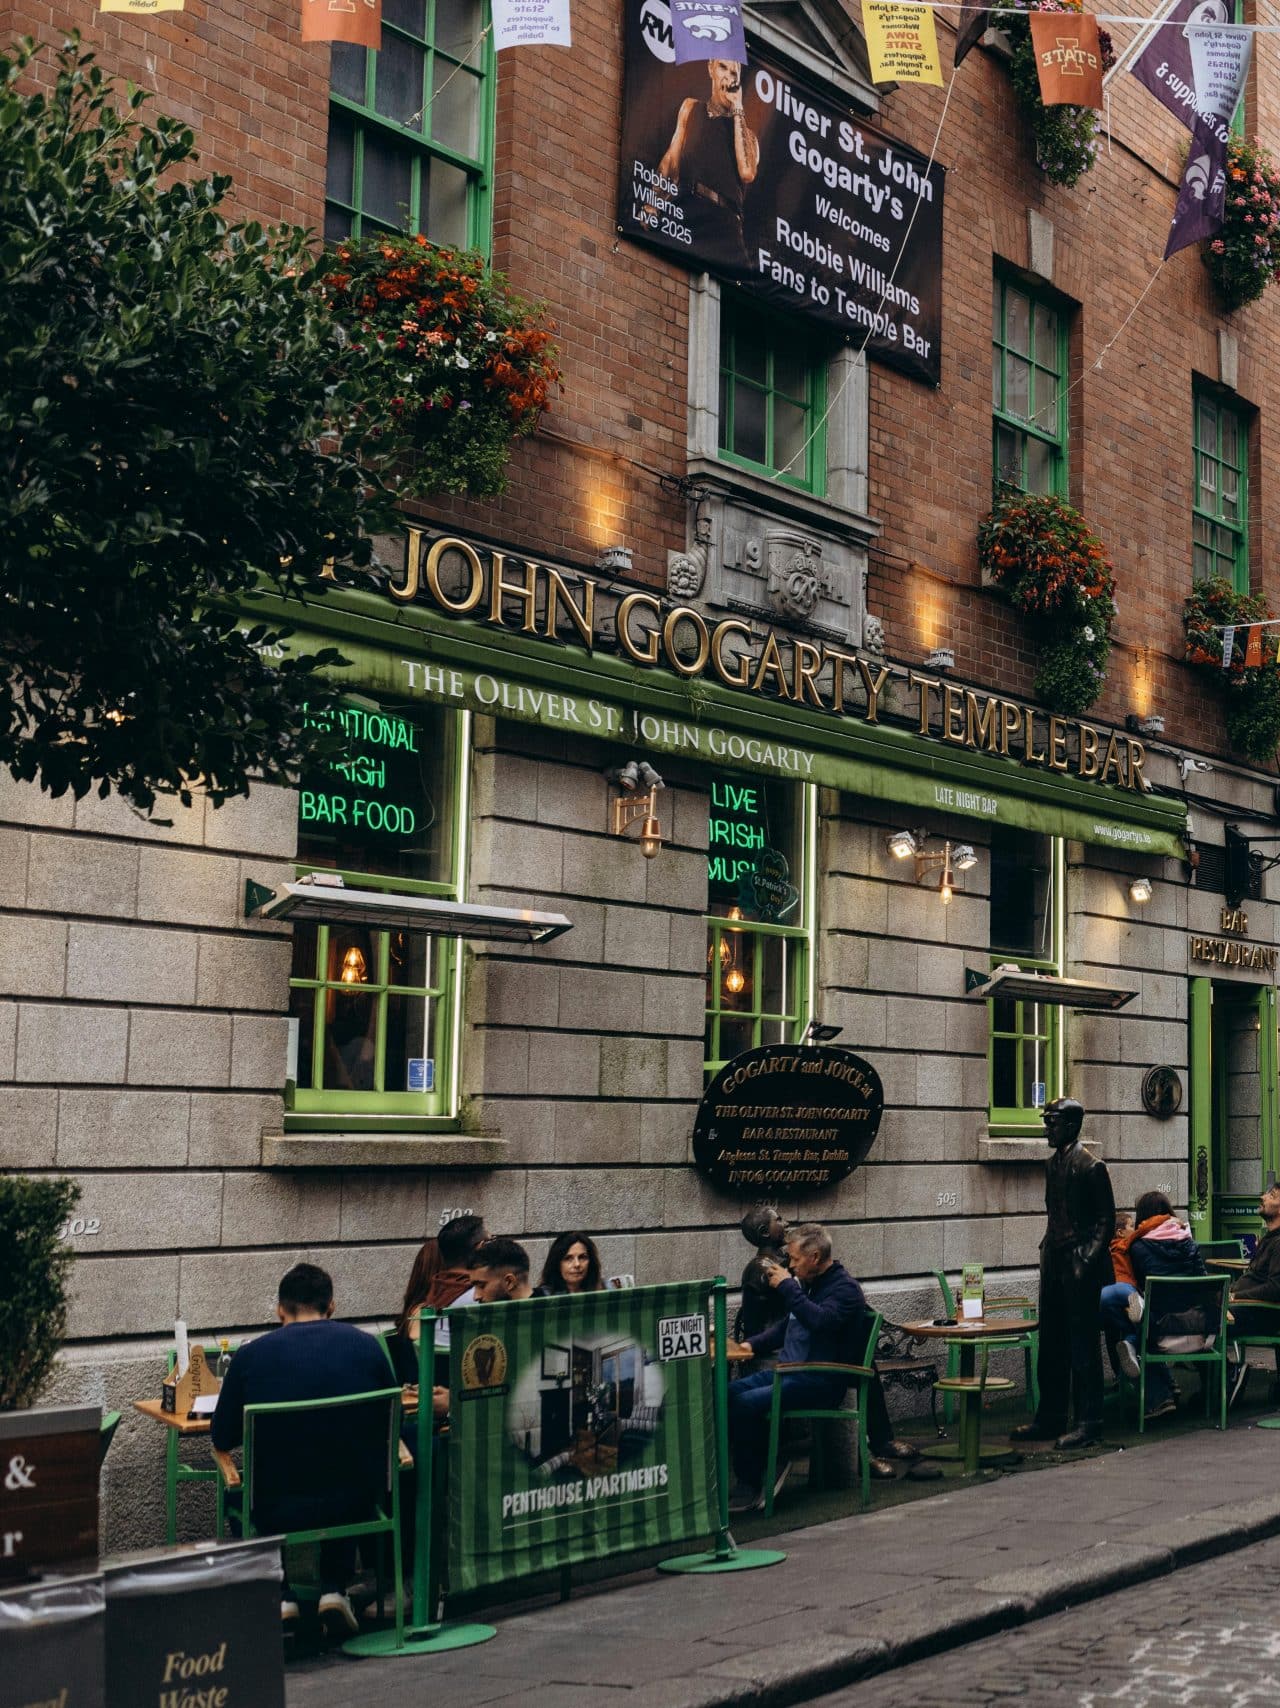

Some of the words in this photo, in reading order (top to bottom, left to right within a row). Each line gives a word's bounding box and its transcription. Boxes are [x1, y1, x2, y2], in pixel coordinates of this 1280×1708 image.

[1155, 62, 1169, 78] &
[1214, 124, 1229, 143] to
[755, 69, 831, 138] Oliver
[838, 126, 870, 164] St.
[879, 149, 932, 201] John
[633, 160, 678, 196] Robbie
[788, 131, 903, 221] Gogarty's
[633, 181, 684, 220] Williams
[632, 203, 659, 228] Live
[661, 217, 693, 245] 2025
[815, 194, 890, 252] Welcomes
[776, 216, 843, 274] Robbie
[849, 255, 920, 315] Williams
[758, 248, 805, 295] Fans
[810, 281, 830, 305] to
[835, 287, 898, 341] Temple
[903, 323, 931, 359] Bar
[388, 526, 598, 656] JOHN
[616, 592, 892, 724] GOGARTY
[909, 672, 1069, 772] TEMPLE
[1079, 723, 1149, 793] BAR
[401, 660, 465, 698] THE
[474, 674, 582, 723] OLIVER
[588, 700, 624, 733] ST.
[633, 710, 700, 750] JOHN
[708, 728, 816, 774] GOGARTY
[302, 791, 347, 825] BAR
[353, 799, 415, 834] FOOD
[712, 782, 758, 813] LIVE
[934, 786, 954, 806] LATE
[955, 790, 981, 811] NIGHT
[982, 797, 998, 816] BAR
[708, 818, 765, 850] IRISH
[1094, 824, 1151, 845] www.gogartys.ie
[1221, 907, 1249, 934] BAR
[1191, 936, 1279, 971] RESTAURANT
[721, 1056, 801, 1095] GOGARTY
[801, 1059, 823, 1074] and
[824, 1060, 863, 1089] JOYCE
[714, 1105, 738, 1118] THE
[739, 1105, 781, 1119] OLIVER
[794, 1107, 824, 1120] JOHN
[823, 1107, 871, 1121] GOGARTY
[742, 1128, 765, 1140] BAR
[765, 1128, 776, 1140] &
[776, 1127, 840, 1142] RESTAURANT
[717, 1149, 757, 1166] Anglesea
[772, 1150, 802, 1164] Temple
[821, 1149, 849, 1161] Dublin
[936, 1192, 957, 1208] 505
[660, 1320, 680, 1336] LATE
[680, 1318, 703, 1334] NIGHT
[662, 1334, 702, 1358] BAR
[4, 1455, 37, 1490] &
[502, 1479, 584, 1519] PENTHOUSE
[586, 1463, 669, 1500] APARTMENTS
[162, 1642, 228, 1684] Food
